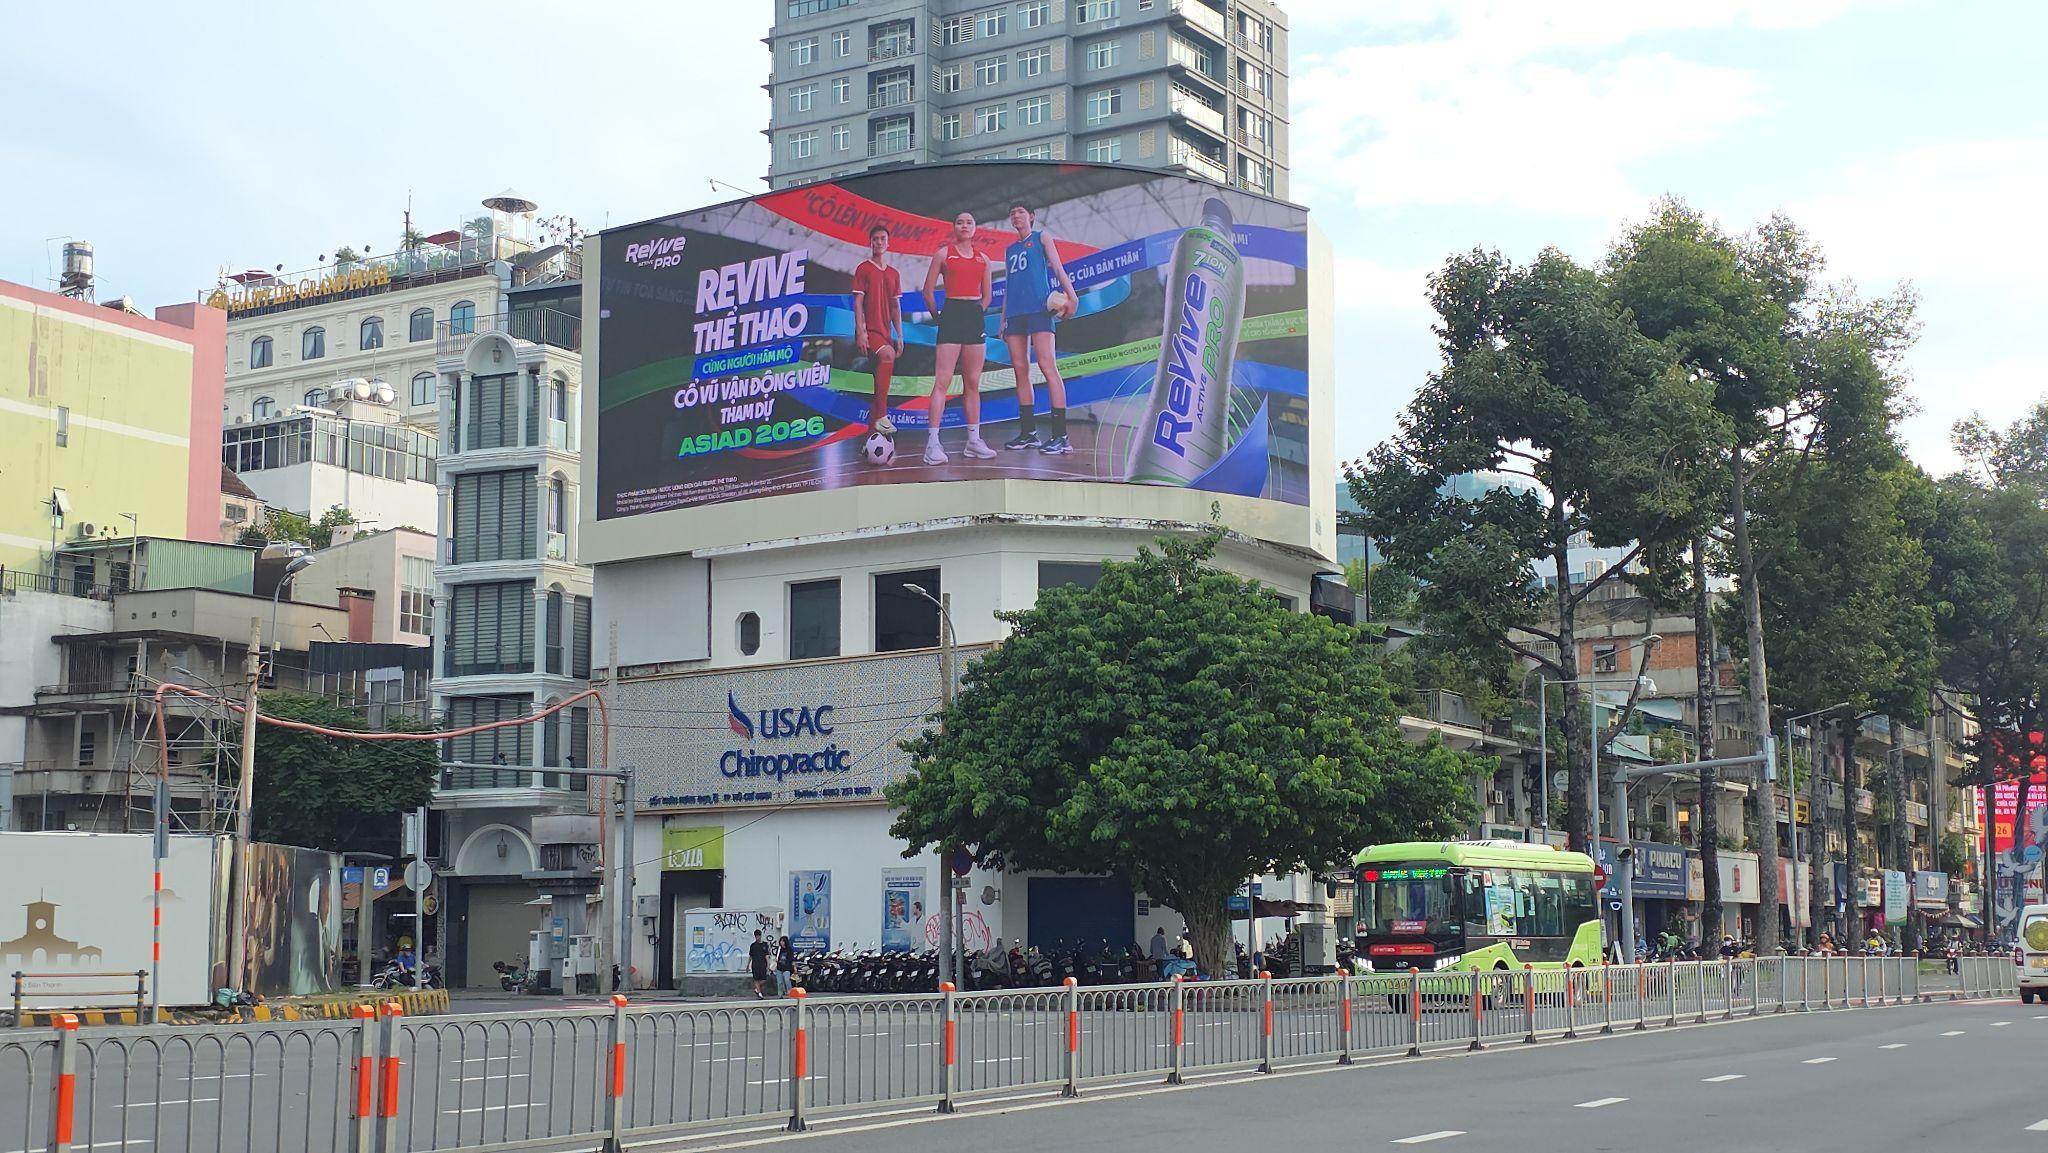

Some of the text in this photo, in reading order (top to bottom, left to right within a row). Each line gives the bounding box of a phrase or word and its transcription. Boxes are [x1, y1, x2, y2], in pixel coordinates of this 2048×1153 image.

[654, 254, 681, 270] PRO
[1010, 250, 1028, 274] 26
[300, 273, 348, 299] GRAND
[349, 265, 391, 290] HOTEL
[695, 249, 809, 314] REVIVE
[693, 303, 809, 355] THỂ THAO
[727, 353, 757, 370] NGƯỜI
[758, 349, 777, 364] HÂM
[777, 345, 794, 362] MỘ
[1153, 271, 1208, 458] ReVive
[1196, 296, 1225, 424] ACTIVE PRO
[674, 361, 831, 409] CỔ VŨ VẬN ĐỘNG VIÊN
[720, 398, 775, 424] THAM DỰ
[897, 412, 916, 425] SÁNG
[678, 416, 825, 457] ASIAD 2026
[760, 704, 834, 739] USAC
[720, 743, 851, 783] Chiropractic
